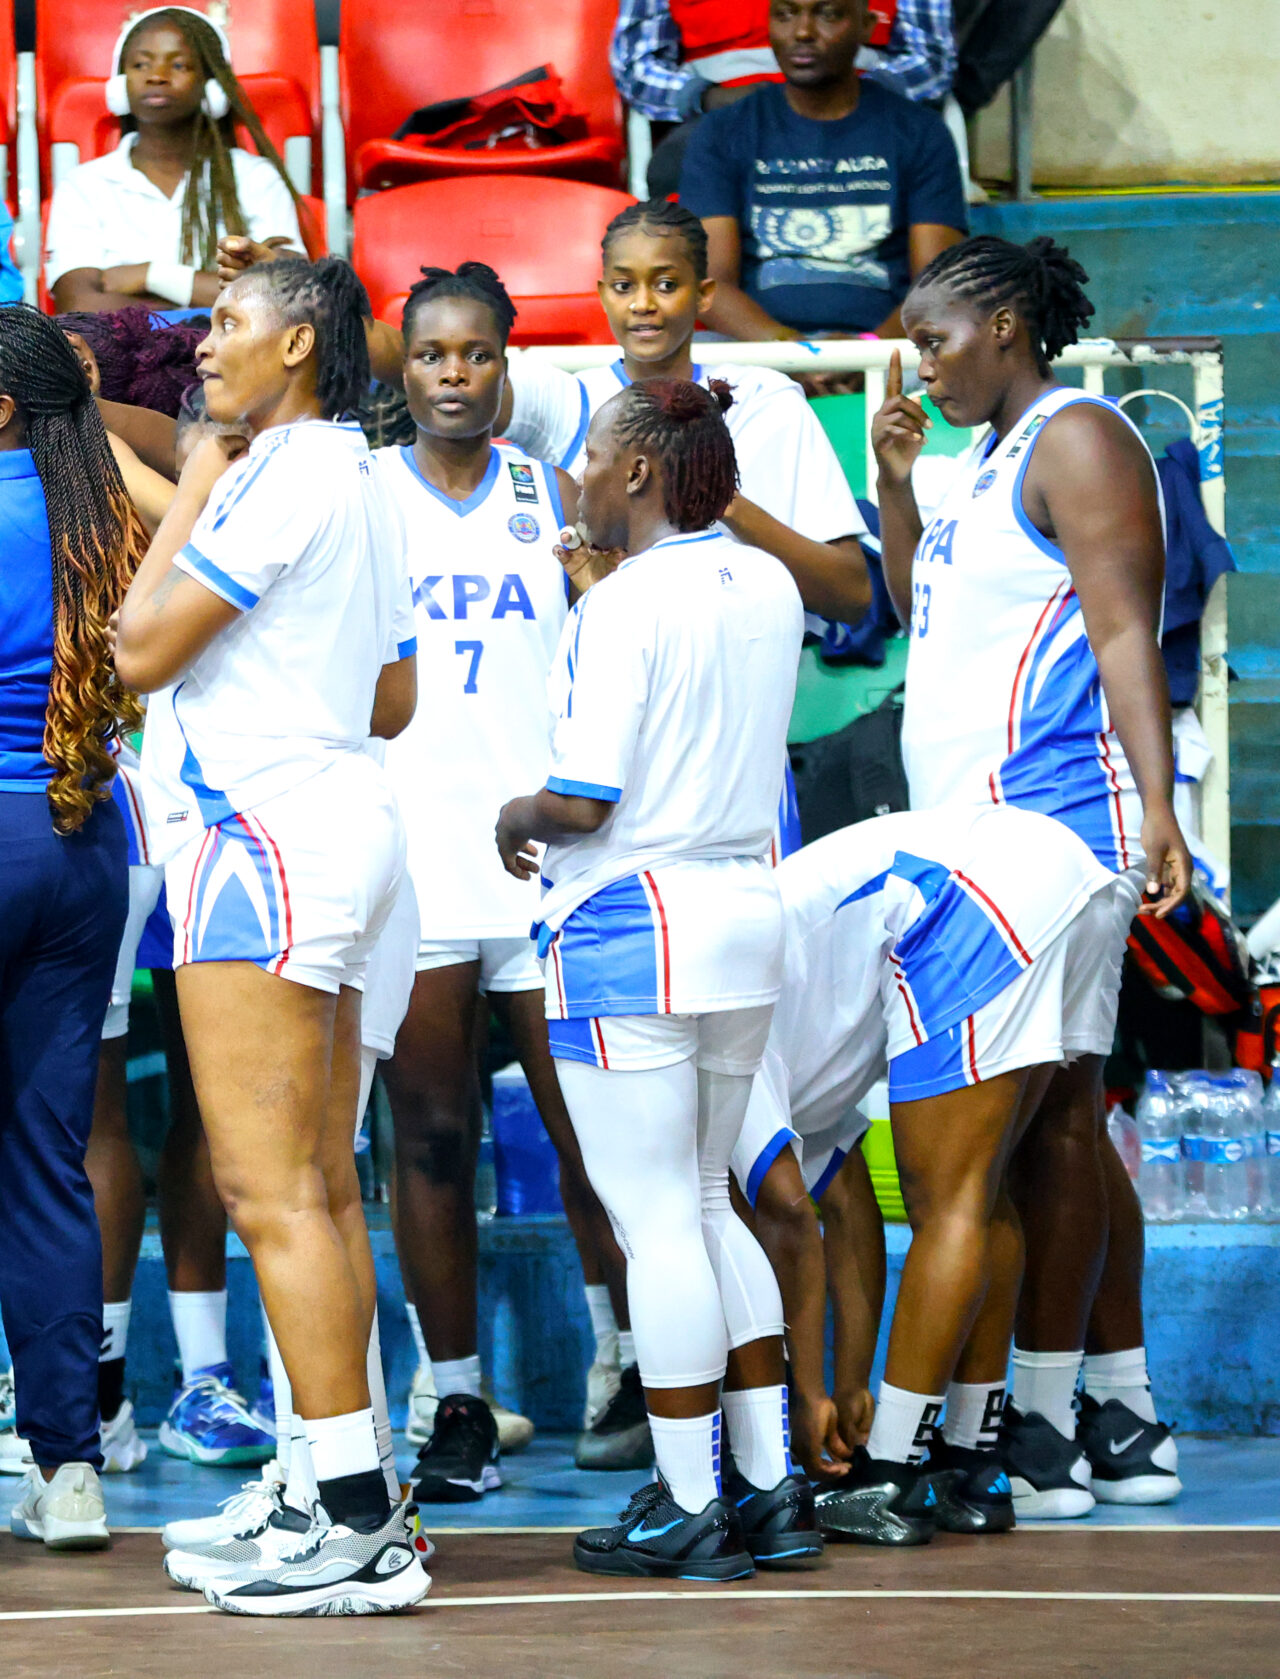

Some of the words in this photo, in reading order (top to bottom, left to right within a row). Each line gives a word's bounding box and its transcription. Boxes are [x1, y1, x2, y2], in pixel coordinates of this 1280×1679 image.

[834, 156, 889, 173] AURA
[827, 181, 847, 193] ALL
[847, 179, 892, 192] AROUND
[408, 573, 537, 620] KPA
[454, 640, 485, 694] 7
